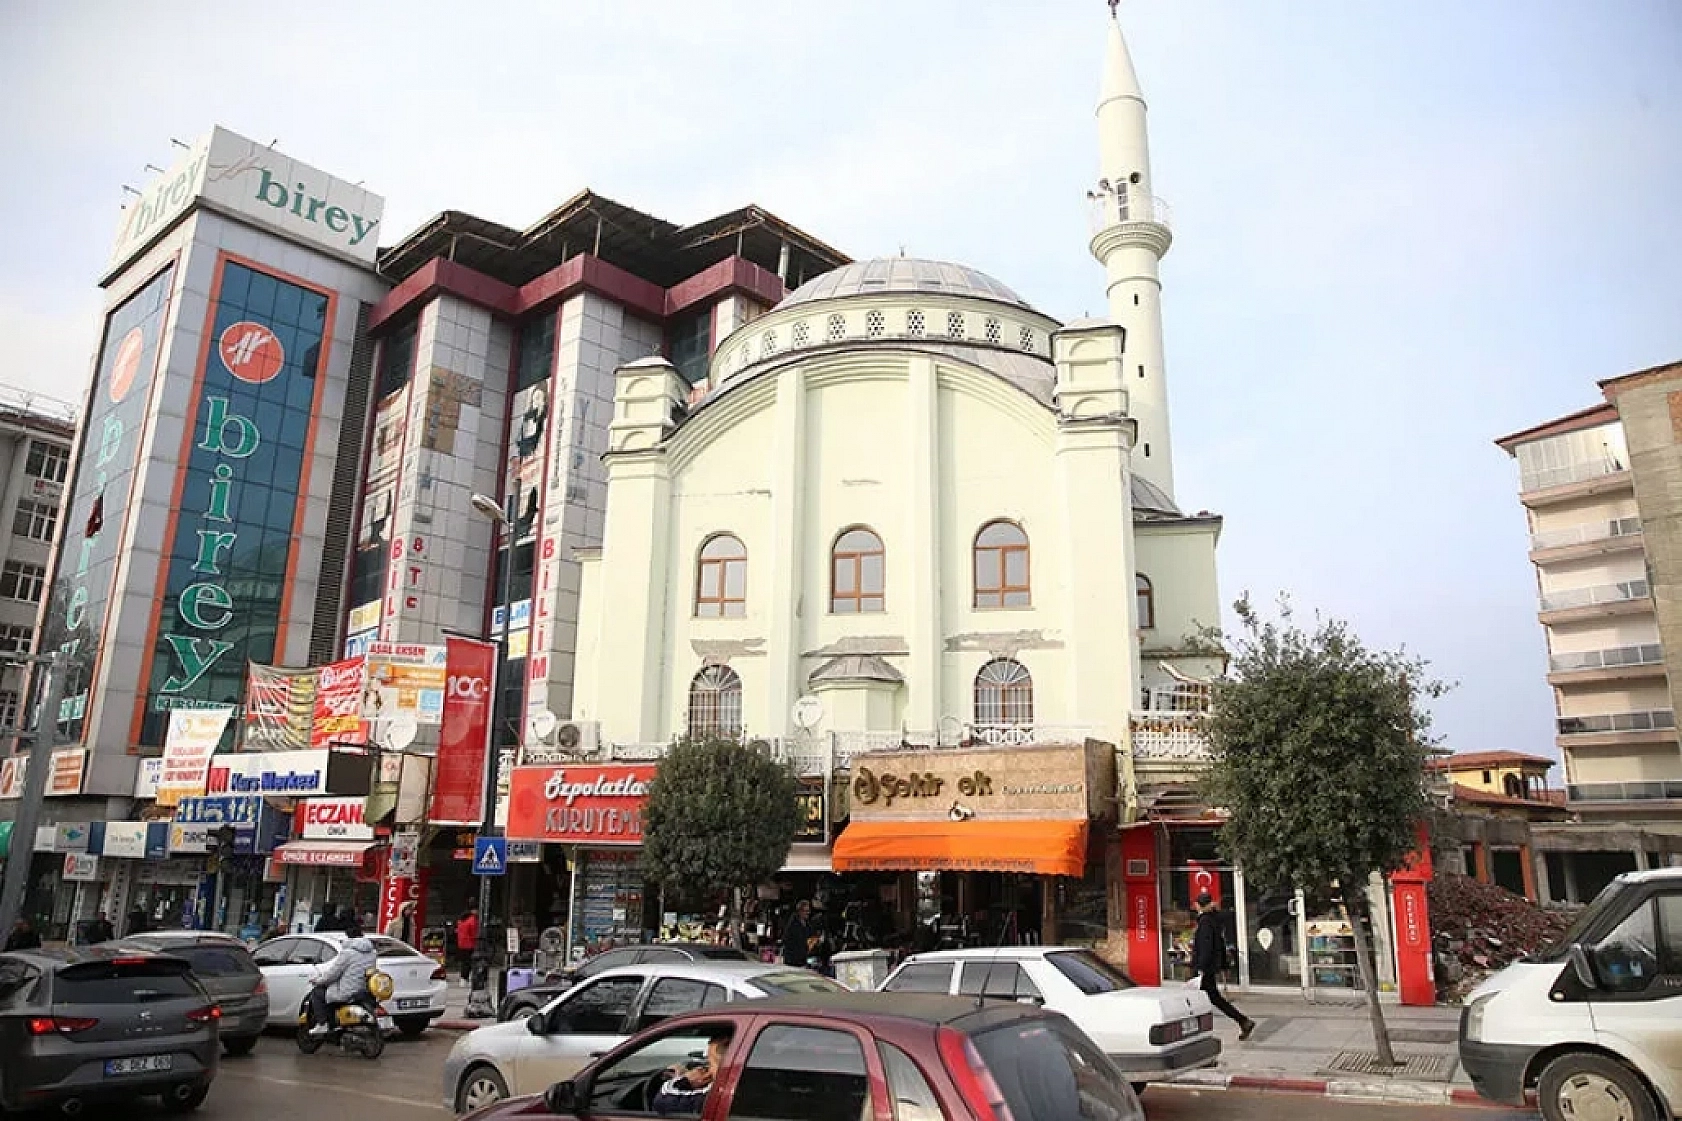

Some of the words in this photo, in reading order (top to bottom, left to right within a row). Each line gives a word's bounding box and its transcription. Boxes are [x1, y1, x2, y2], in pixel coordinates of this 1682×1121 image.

[131, 147, 206, 241] birey
[254, 165, 380, 246] birey
[160, 396, 260, 692] birey
[531, 536, 555, 680] BİLİM
[308, 803, 366, 824] ECZAN
[545, 804, 643, 834] KURUYEMİ
